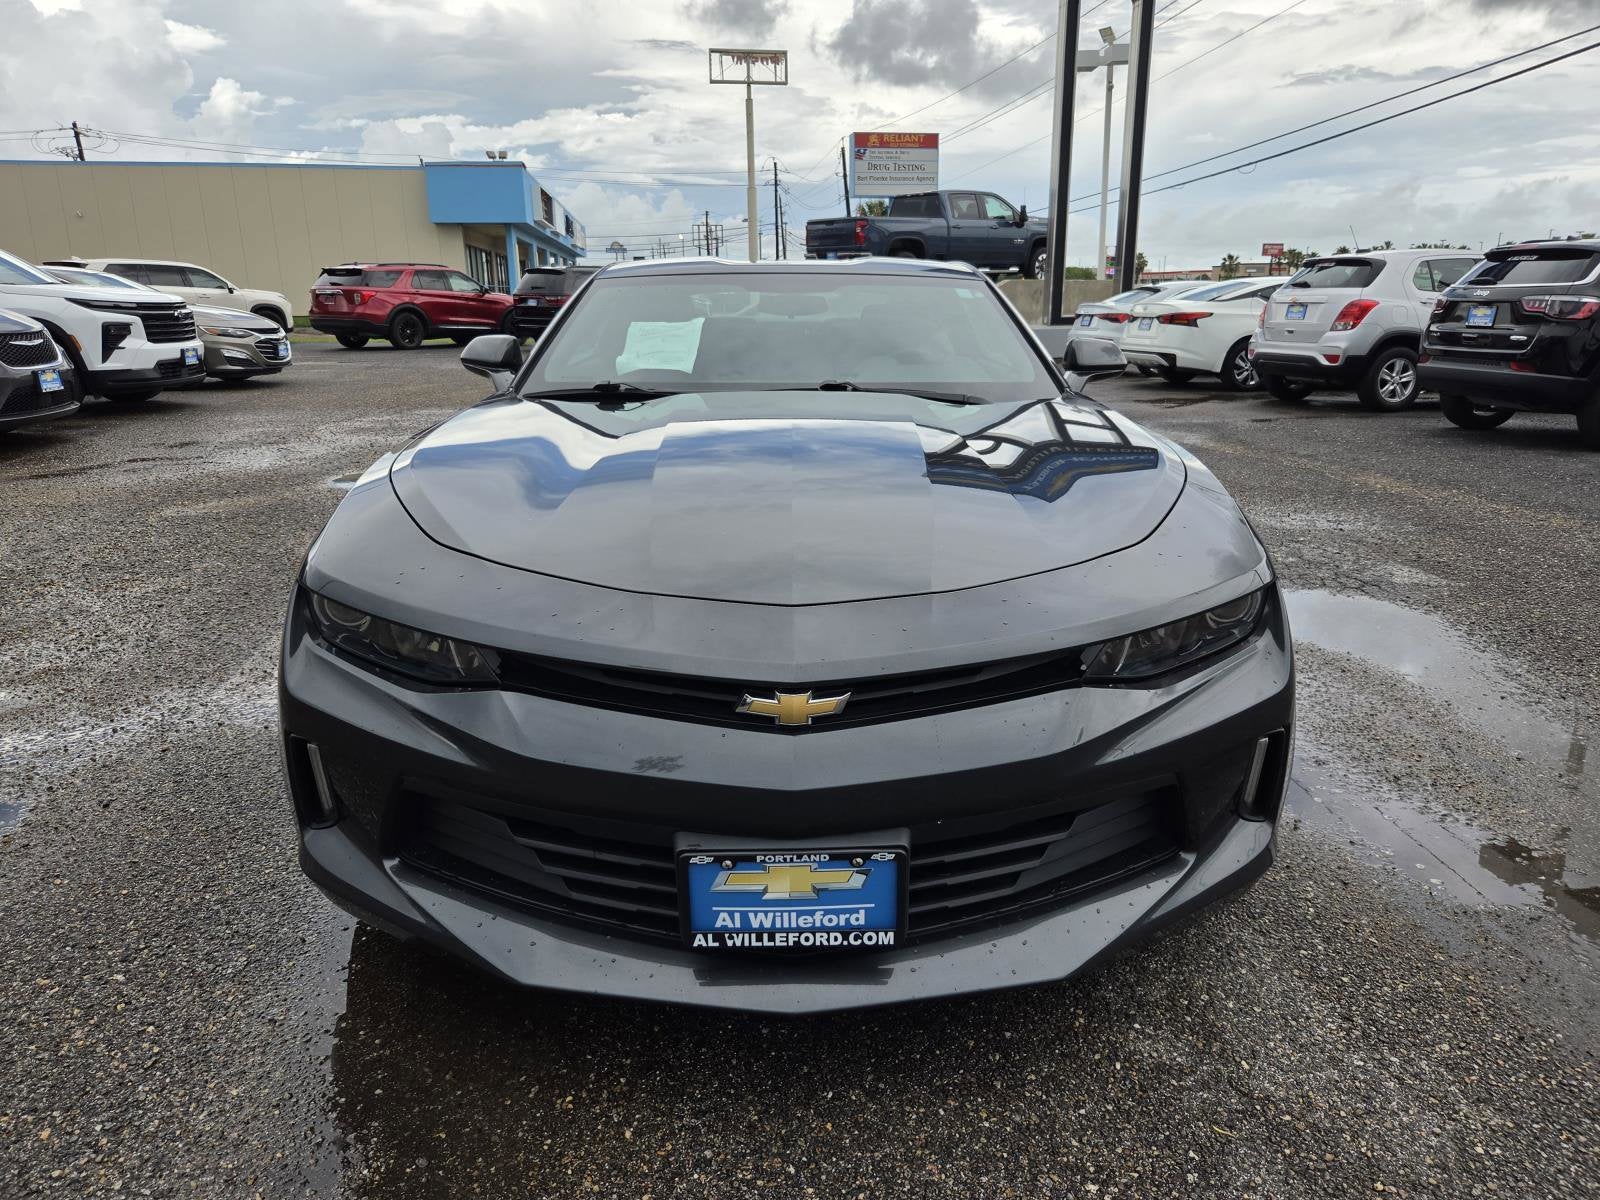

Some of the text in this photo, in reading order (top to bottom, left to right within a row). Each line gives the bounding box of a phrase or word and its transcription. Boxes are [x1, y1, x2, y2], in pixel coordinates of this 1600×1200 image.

[884, 134, 925, 143] RELIANT
[867, 162, 925, 171] DRUG TESTING
[756, 854, 830, 863] PORTLAND
[714, 909, 865, 928] Al Willeford
[693, 931, 895, 947] AL WILLEFORD.COM
